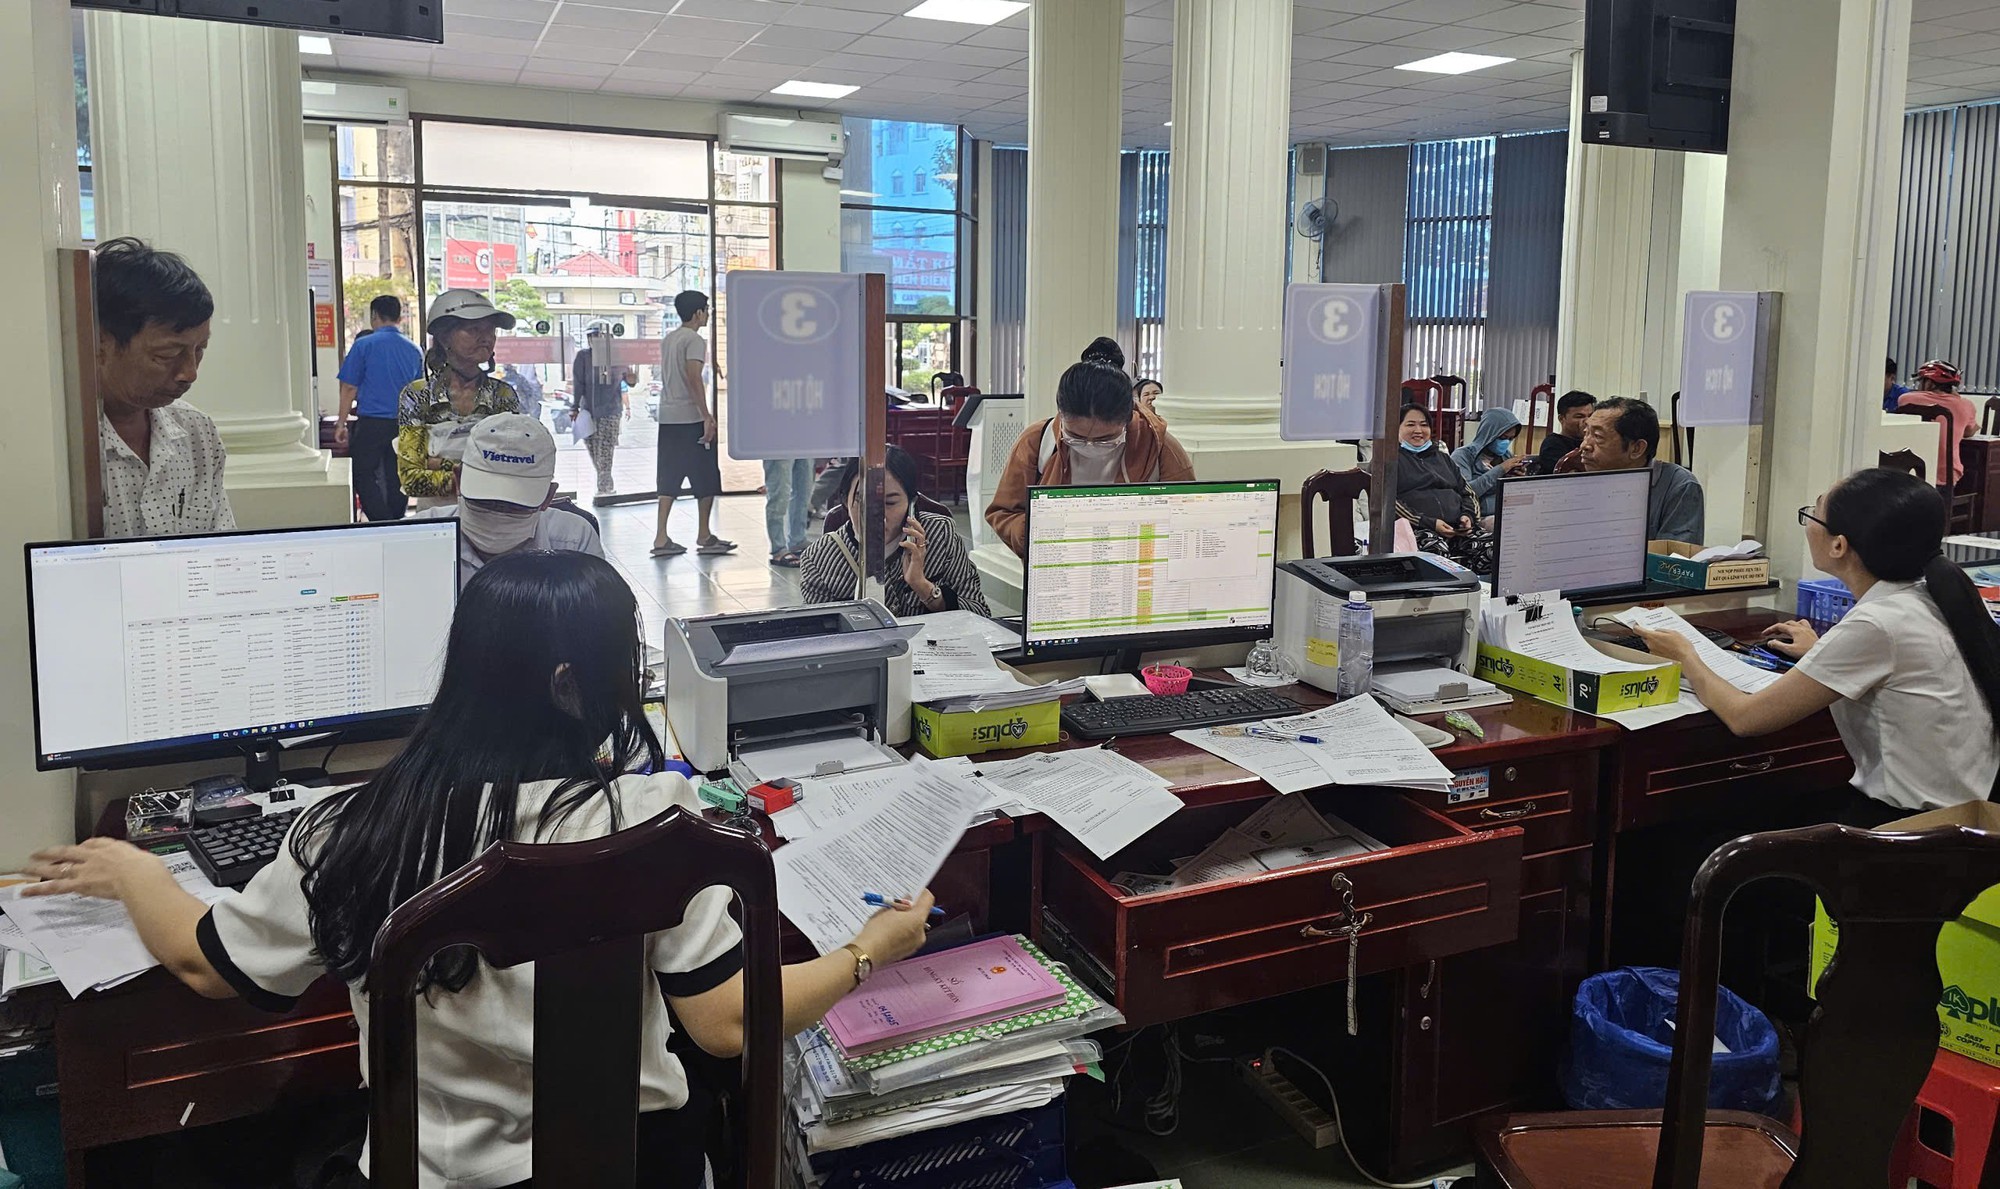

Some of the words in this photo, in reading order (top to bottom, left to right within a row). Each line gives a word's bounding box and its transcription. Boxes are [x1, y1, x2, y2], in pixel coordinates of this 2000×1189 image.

[482, 449, 536, 464] Vietravel
[1671, 567, 1695, 578] PAPER
[1553, 674, 1562, 693] A4
[1579, 683, 1589, 699] 70
[1624, 677, 1650, 699] plus
[977, 719, 1013, 743] plus
[1955, 1035, 1991, 1052] COPYING
[1964, 1032, 1984, 1043] FAST
